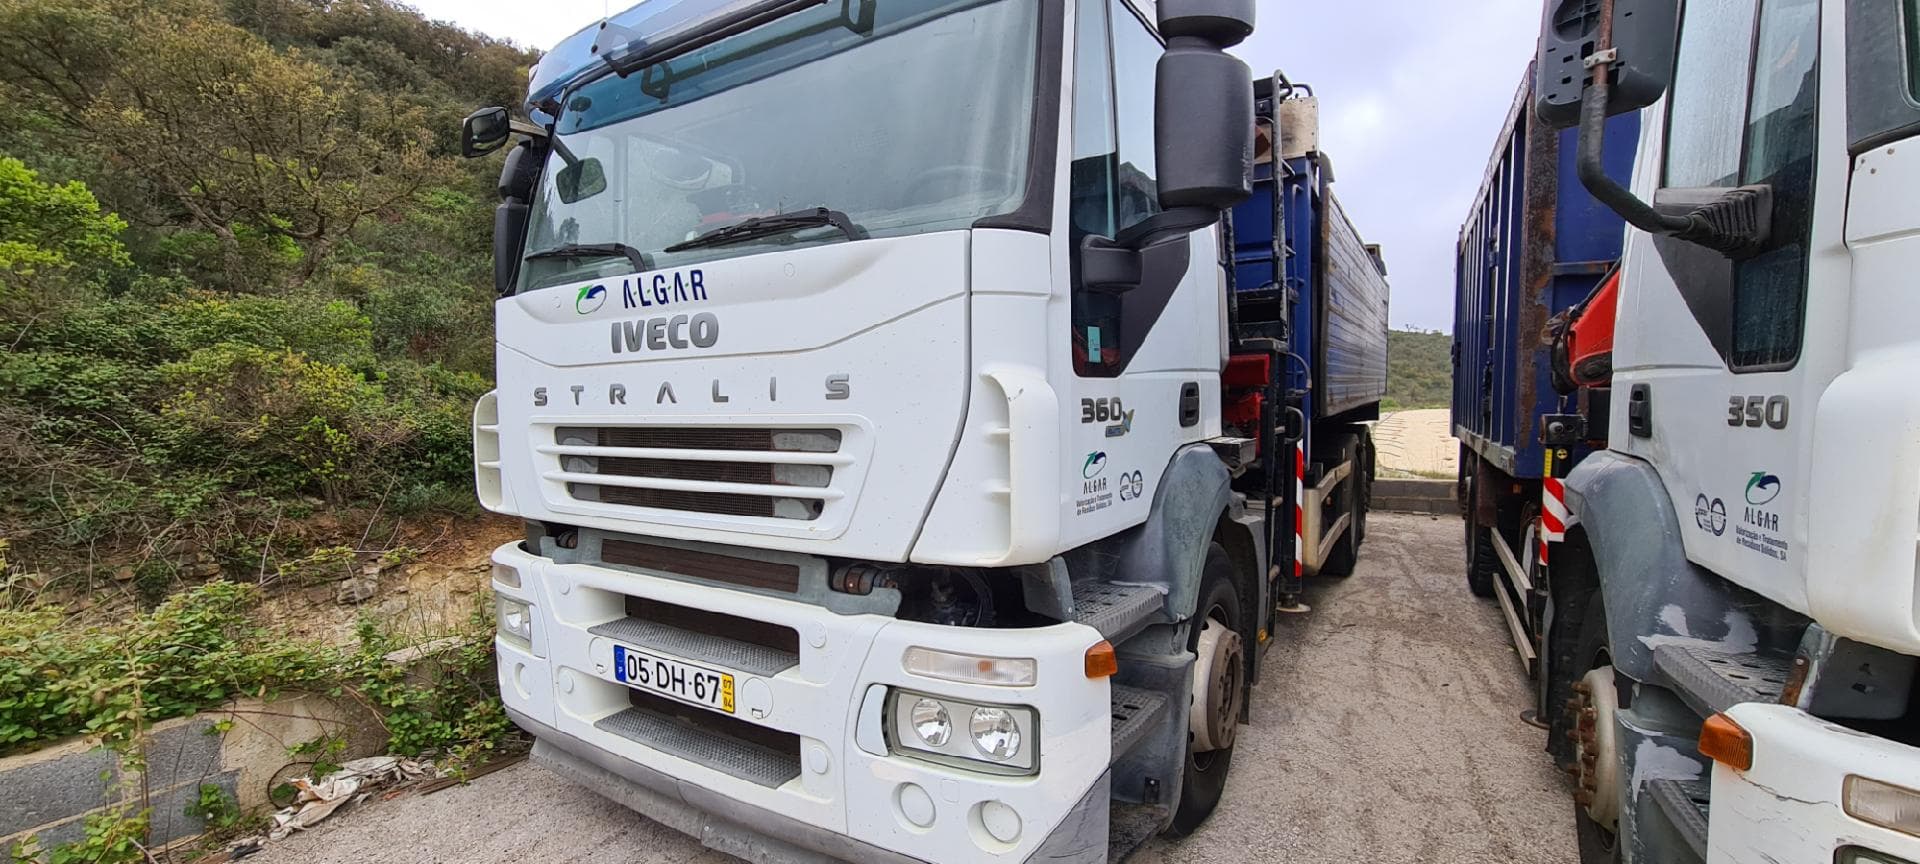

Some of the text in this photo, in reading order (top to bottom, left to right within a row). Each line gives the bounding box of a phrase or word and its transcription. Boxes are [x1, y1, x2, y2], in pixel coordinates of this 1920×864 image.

[611, 311, 719, 354] IVECO
[534, 373, 850, 407] STRALIS
[1081, 396, 1123, 424] 360
[1728, 394, 1790, 430] 350
[1083, 477, 1107, 495] ALGAR
[1744, 506, 1779, 532] ALGAR
